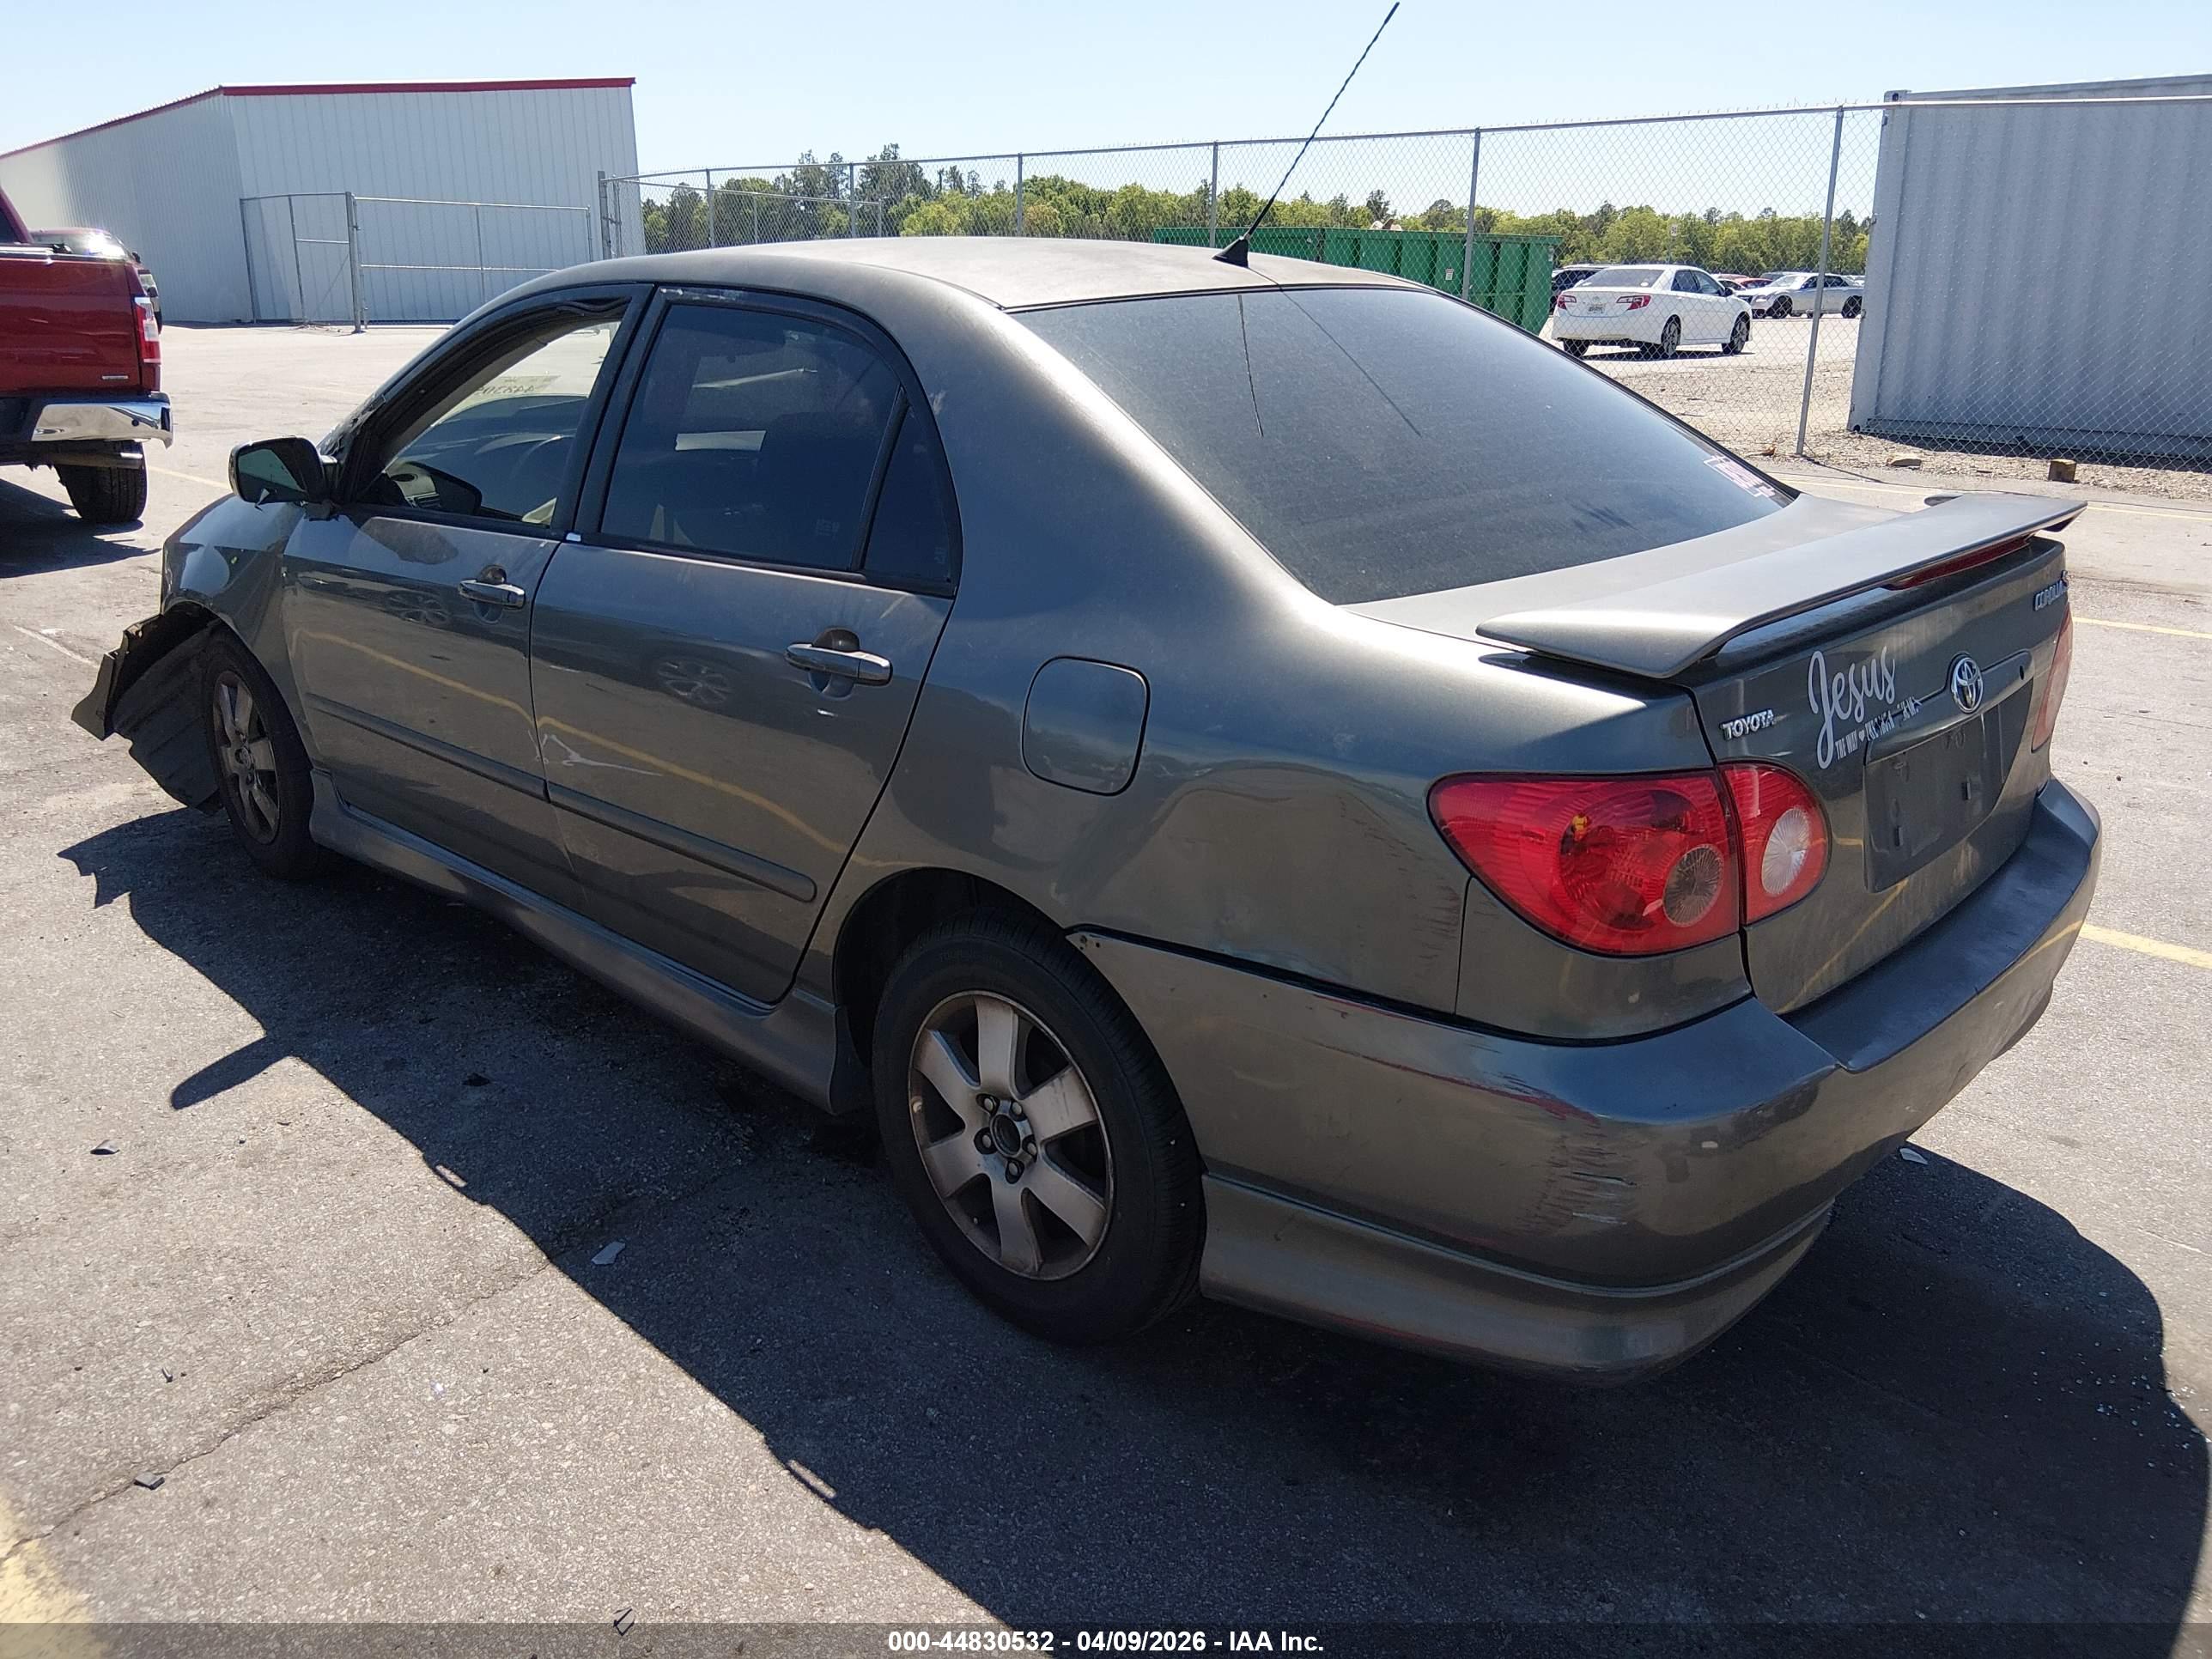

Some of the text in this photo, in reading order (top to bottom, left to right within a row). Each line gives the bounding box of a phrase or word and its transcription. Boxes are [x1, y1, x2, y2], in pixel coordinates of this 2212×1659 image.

[1808, 646, 1895, 769] Jesus
[1721, 709, 1775, 740] TOYOTA
[1835, 738, 1846, 760] THE
[1846, 730, 1857, 754] WAY
